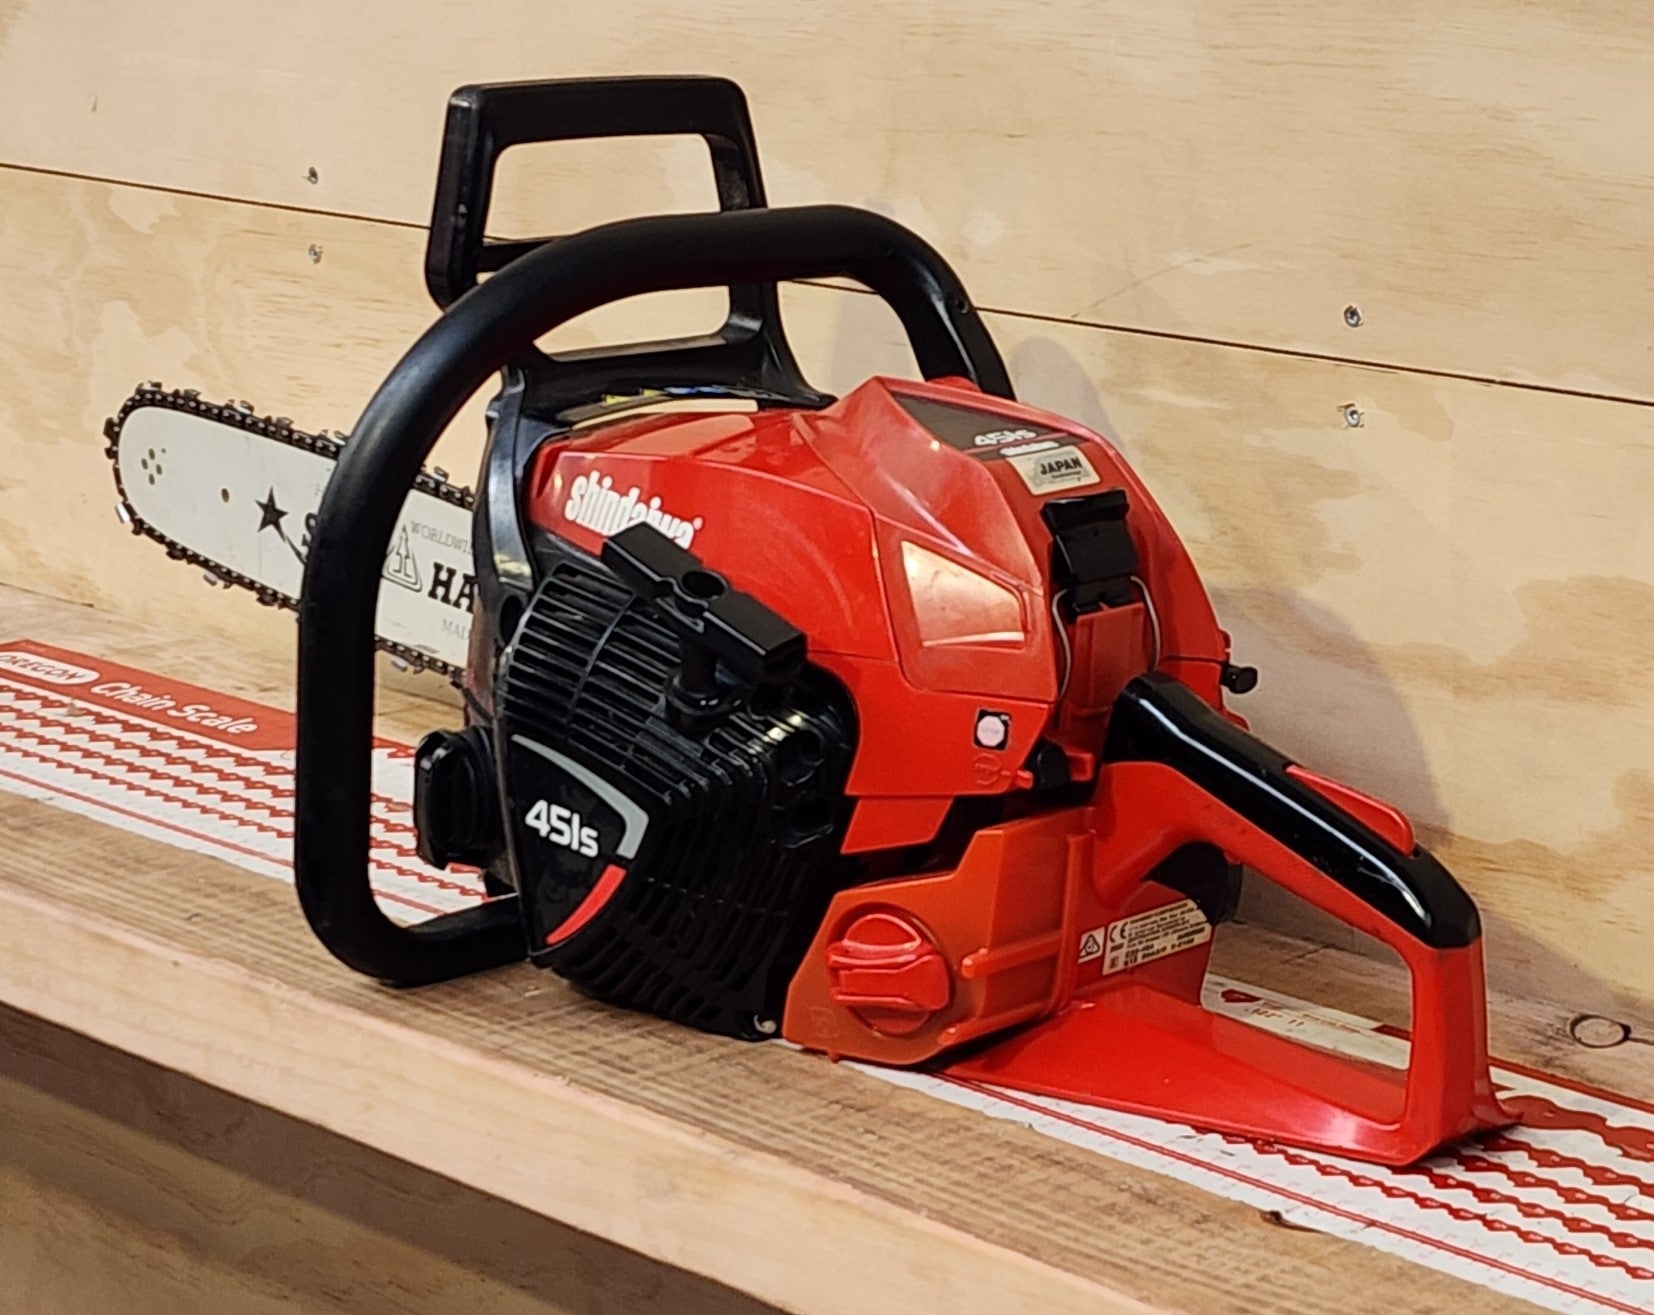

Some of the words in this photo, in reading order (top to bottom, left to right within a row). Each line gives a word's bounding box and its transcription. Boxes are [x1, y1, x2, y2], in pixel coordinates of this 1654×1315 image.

[1040, 456, 1083, 476] JAPAN
[0, 654, 86, 681] OREGON
[90, 682, 176, 711] Chain
[167, 704, 258, 734] Scale
